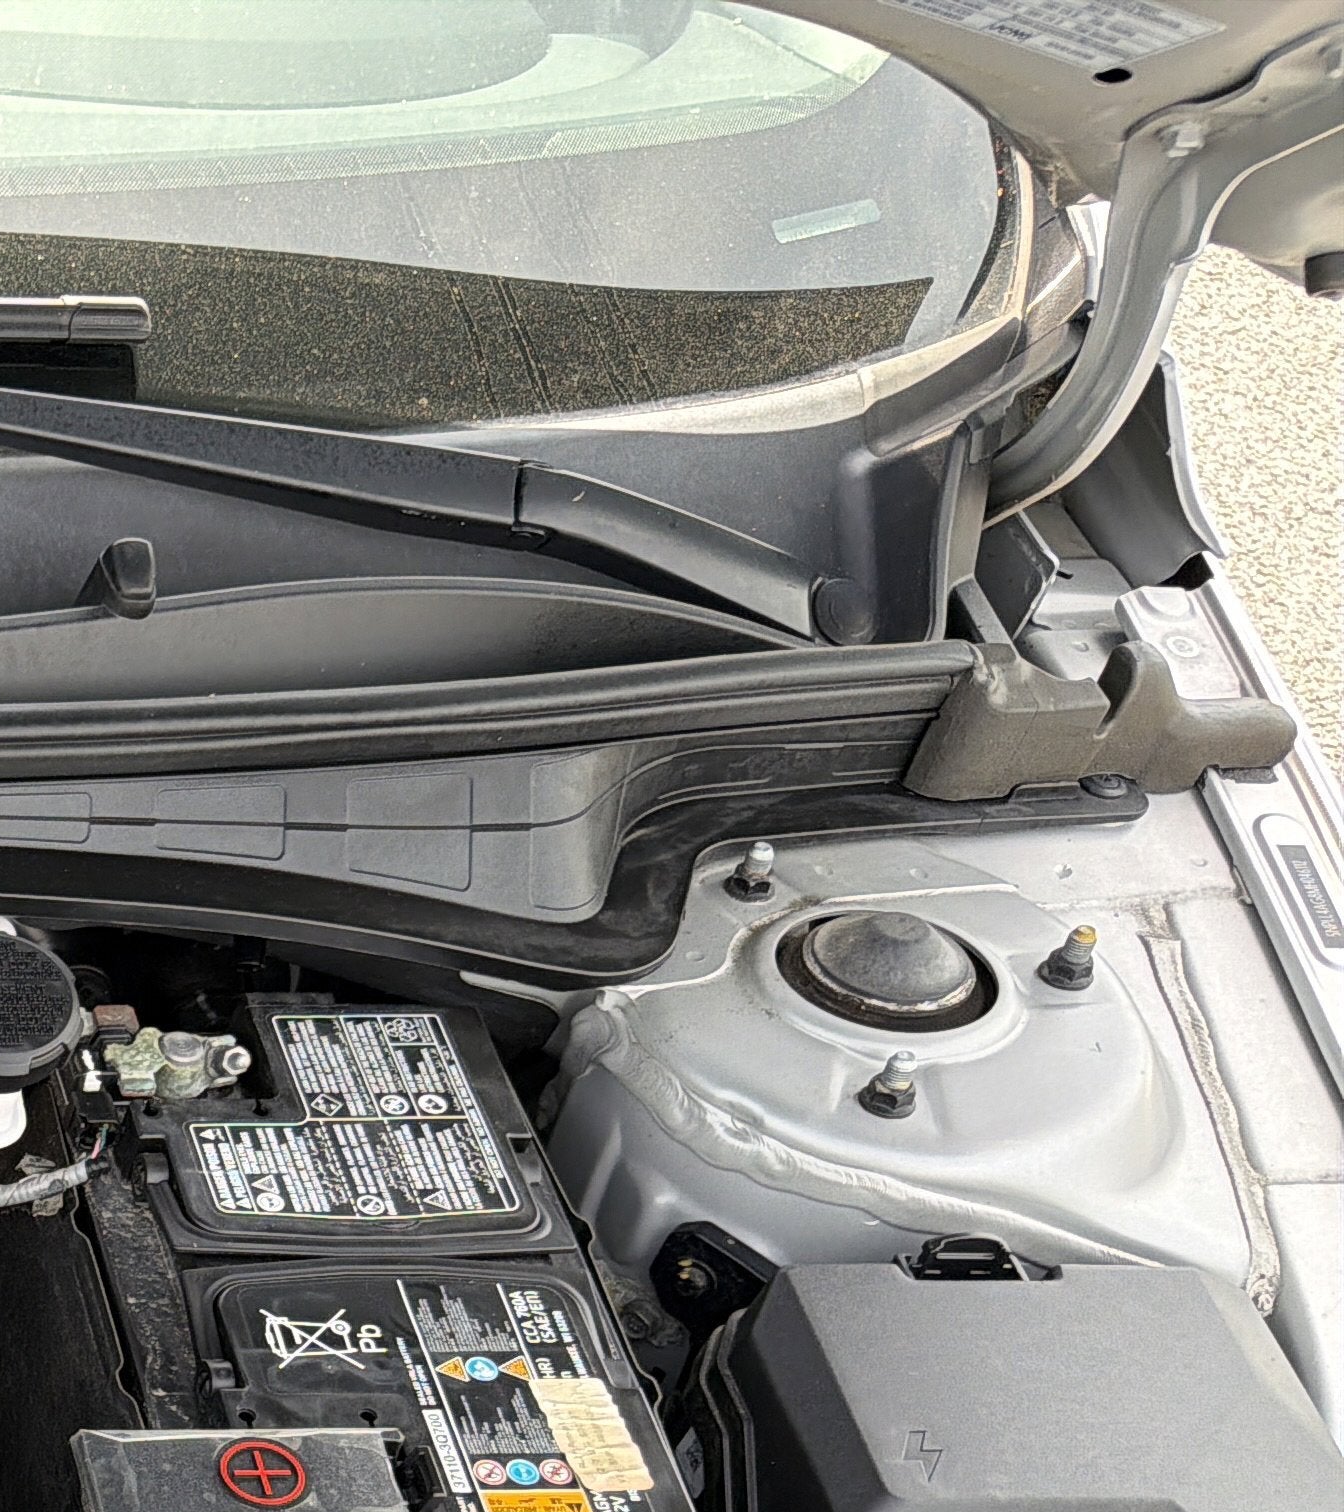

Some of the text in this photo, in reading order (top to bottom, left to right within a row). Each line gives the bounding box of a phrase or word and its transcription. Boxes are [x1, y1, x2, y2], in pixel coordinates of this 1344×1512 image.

[358, 1323, 388, 1356] Pb
[507, 1290, 542, 1343] CCA 760A
[428, 1413, 466, 1488] 37110-3Q700
